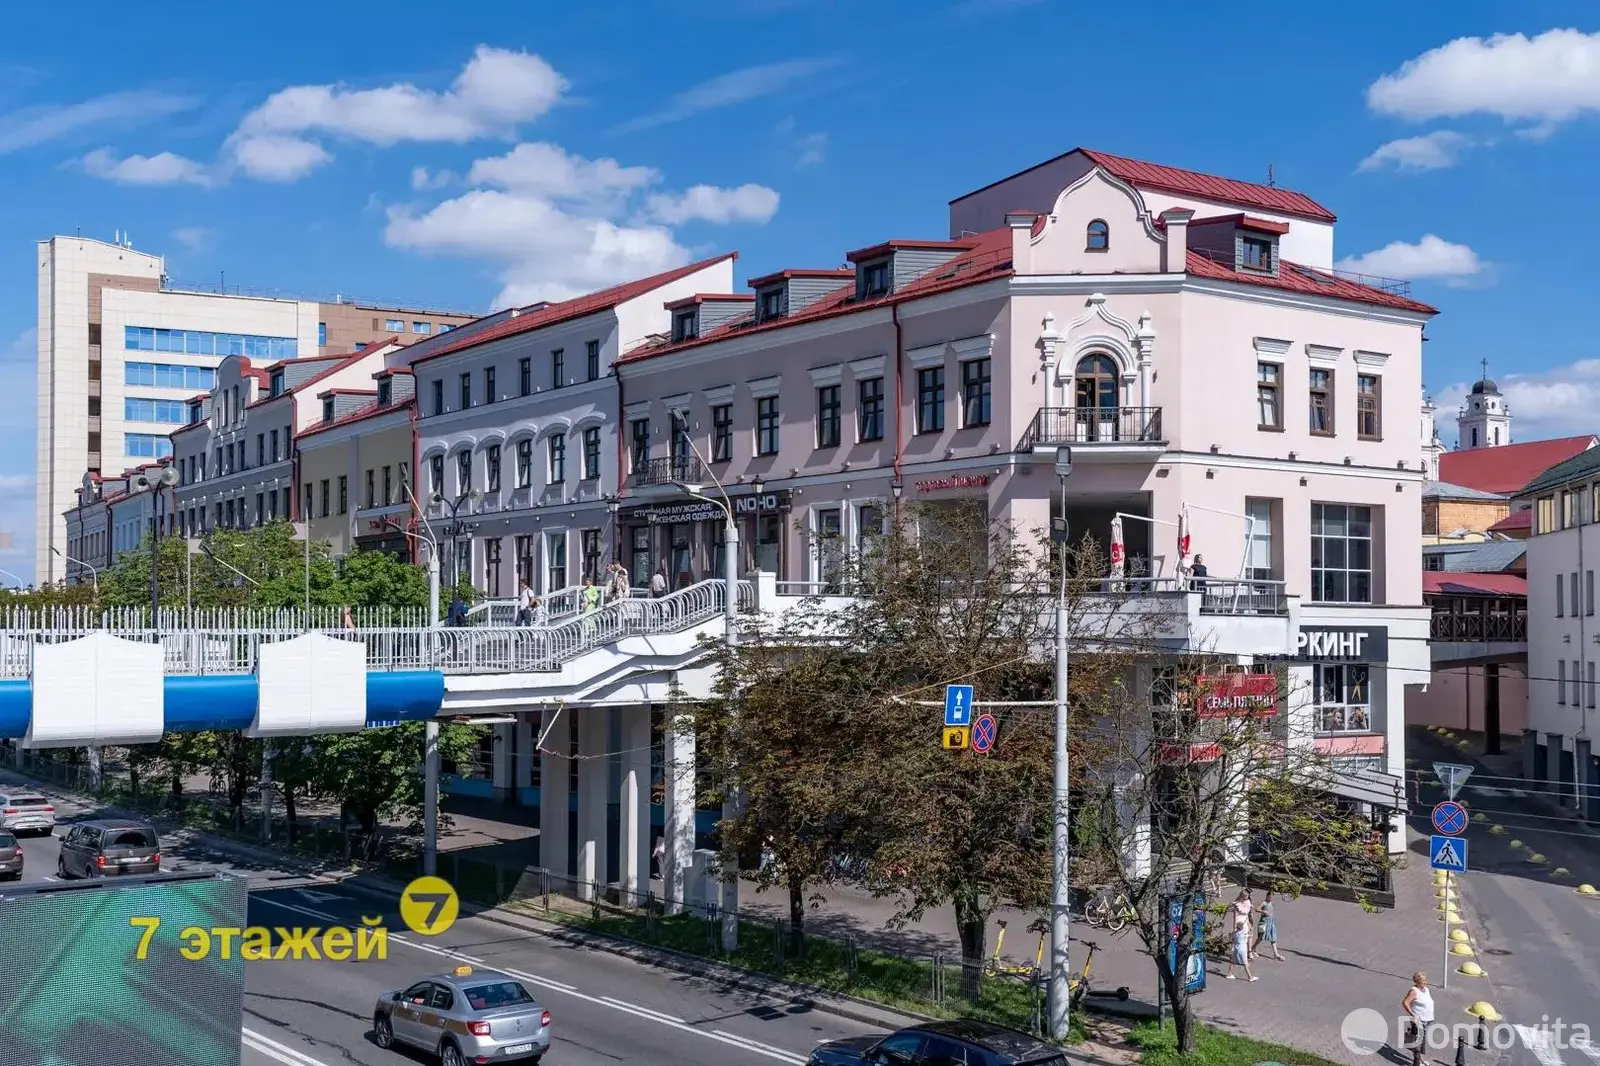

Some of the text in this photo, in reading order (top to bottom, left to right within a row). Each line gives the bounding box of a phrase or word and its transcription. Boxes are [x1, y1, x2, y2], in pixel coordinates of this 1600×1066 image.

[633, 503, 712, 518] СТИНАЯ МУЖСКАЯ
[736, 495, 777, 512] NOHO
[654, 510, 726, 524] ЖЕНСКАЯ ОДЕЖДА
[1296, 631, 1369, 656] РКИНГ
